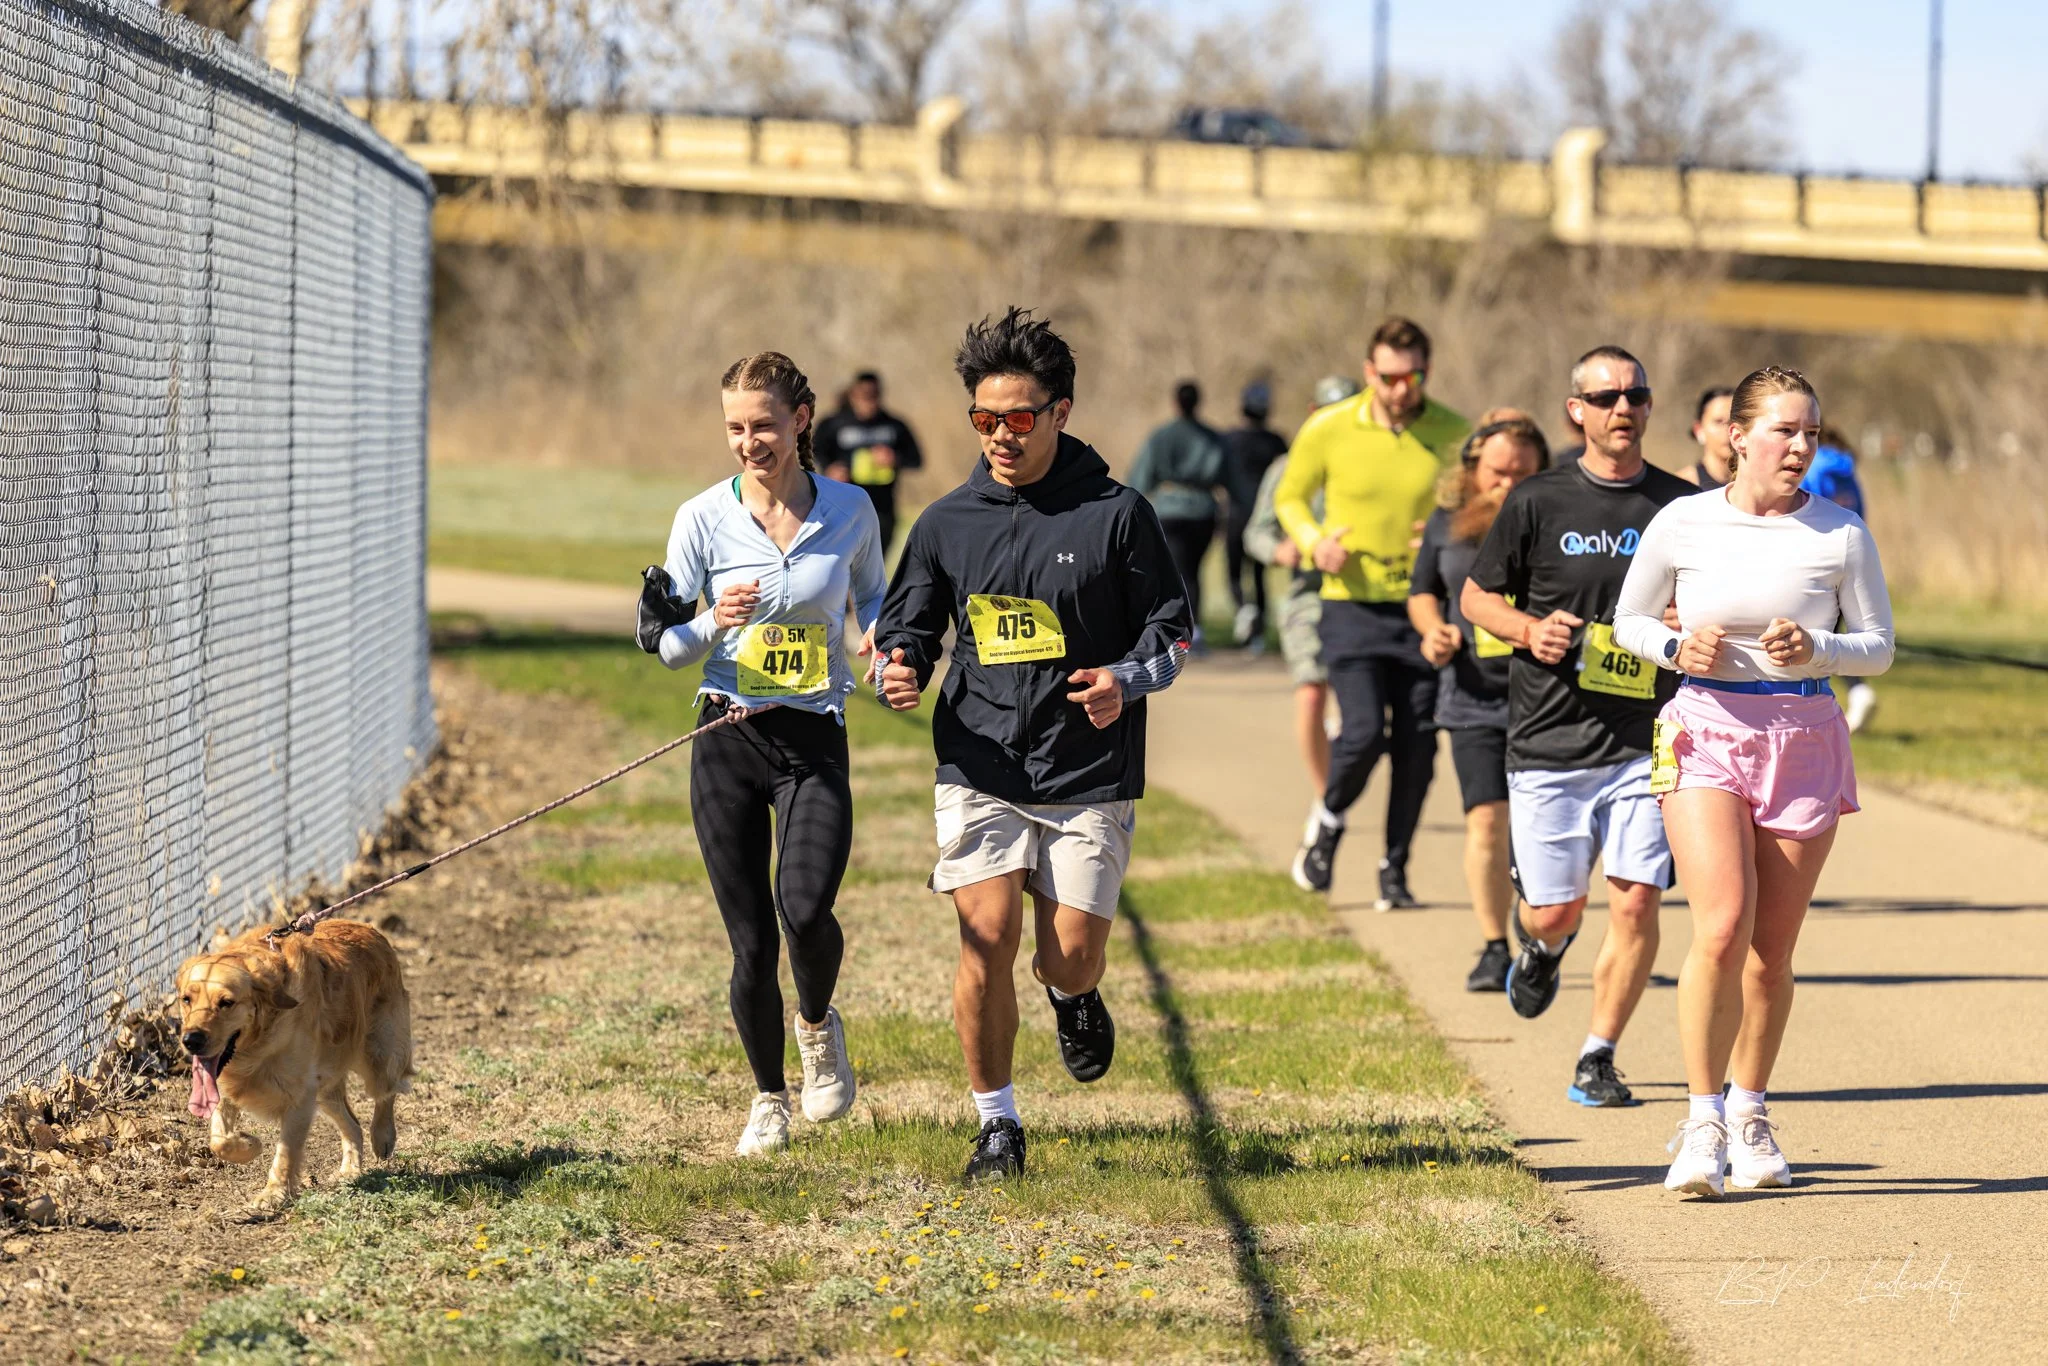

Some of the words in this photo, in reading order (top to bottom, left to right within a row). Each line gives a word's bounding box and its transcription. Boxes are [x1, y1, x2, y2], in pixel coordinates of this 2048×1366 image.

[1560, 528, 1640, 558] OnlyD
[788, 628, 806, 643] 5K
[997, 612, 1036, 641] 475
[762, 650, 804, 675] 474
[1601, 651, 1641, 678] 465
